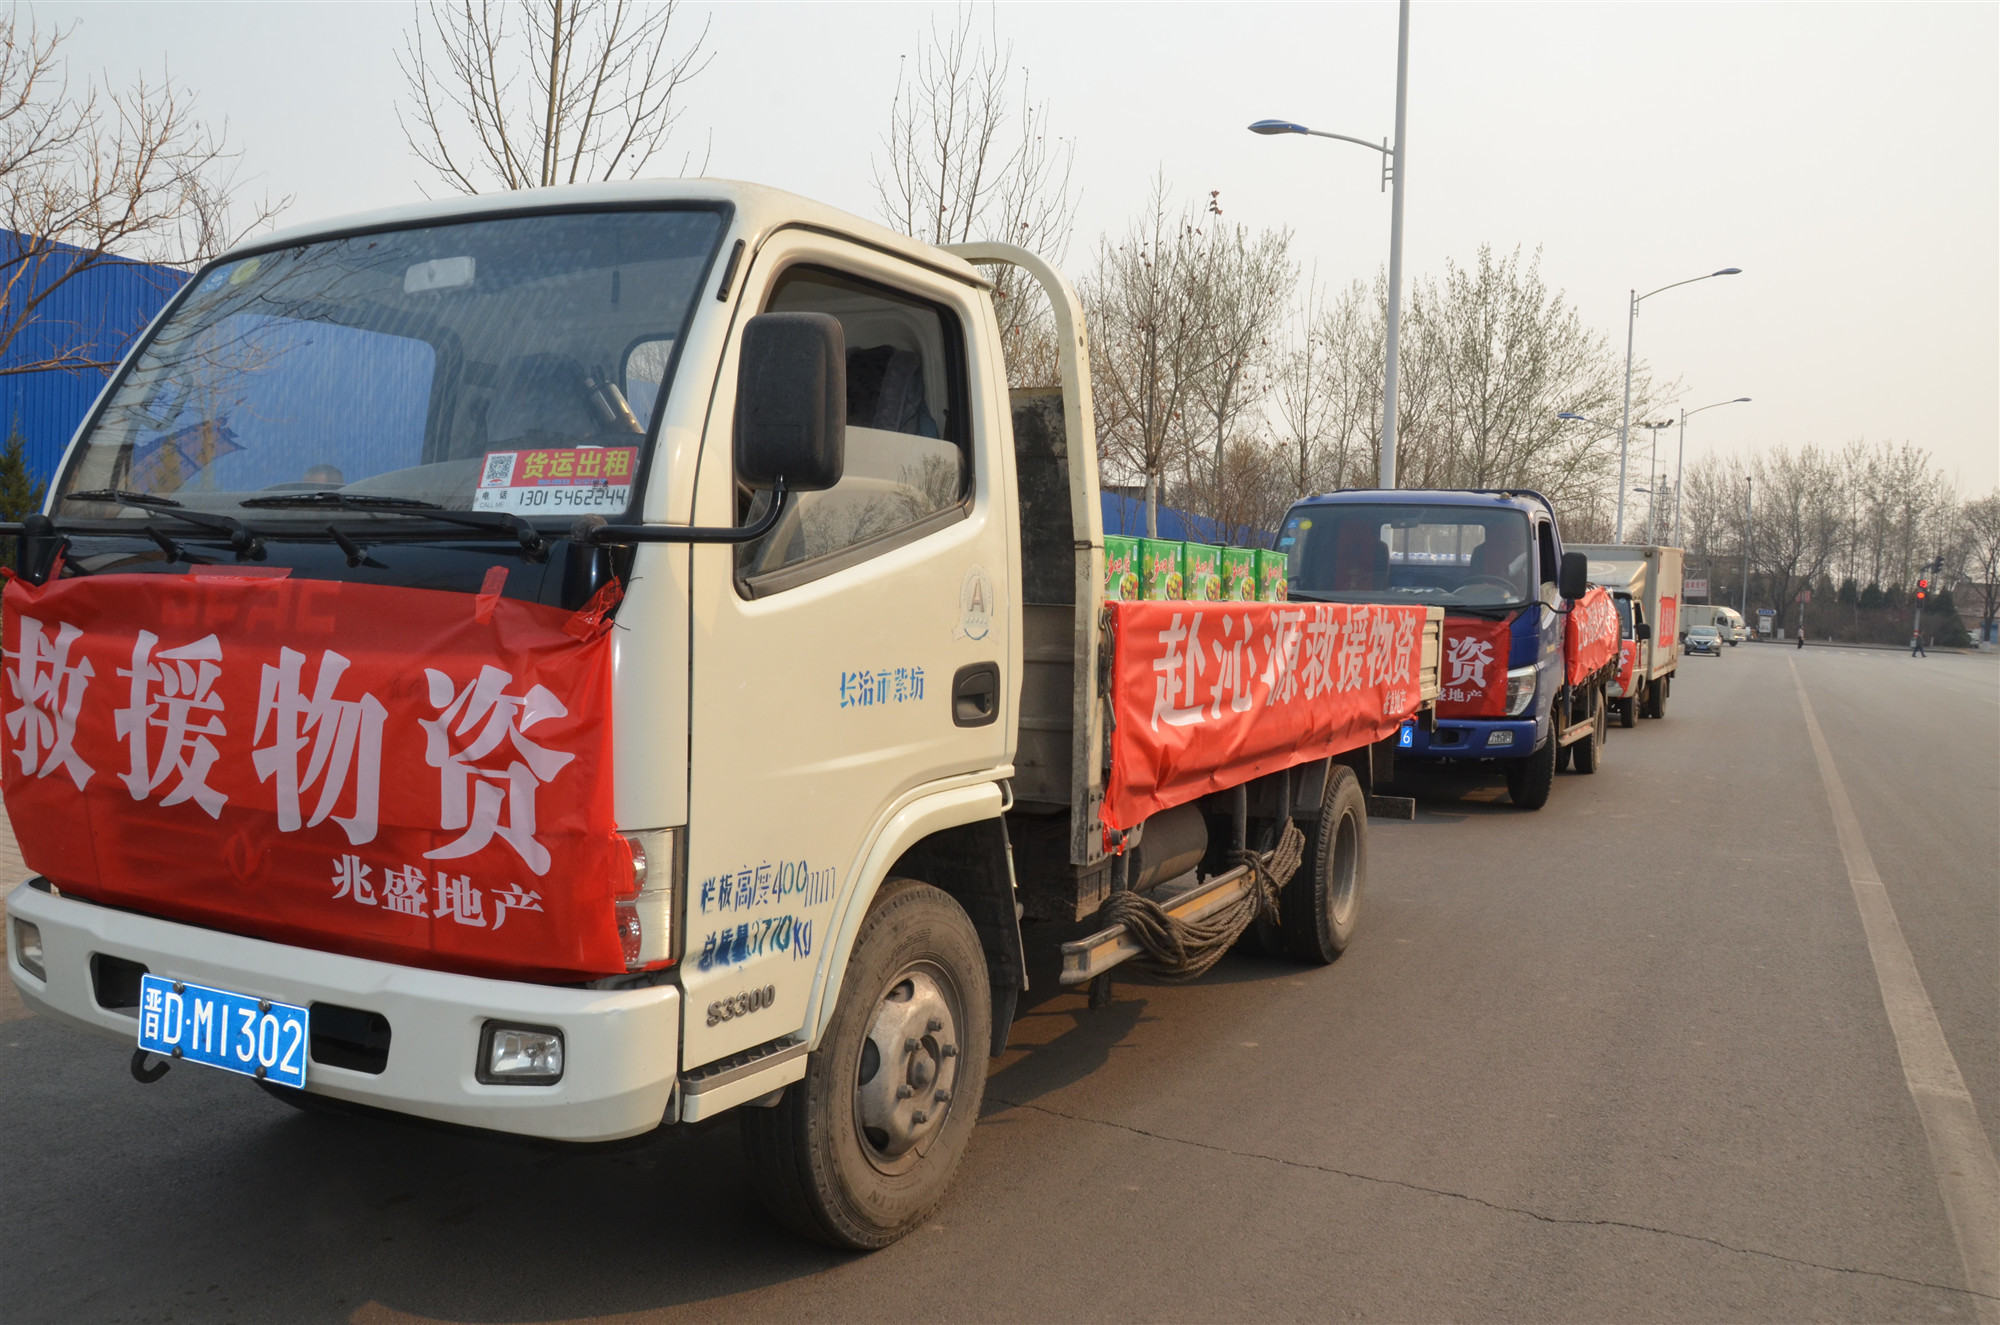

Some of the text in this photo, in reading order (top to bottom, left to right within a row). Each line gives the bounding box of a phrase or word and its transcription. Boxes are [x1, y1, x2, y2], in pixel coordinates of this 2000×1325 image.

[522, 450, 631, 479] 货运出租
[482, 490, 508, 500] 电话
[1151, 604, 1418, 733] 赴沁源救援物资
[1446, 635, 1495, 688] 资
[2, 614, 575, 876] 救援物资
[331, 853, 545, 931] 兆盛地产
[706, 983, 776, 1028] S3300
